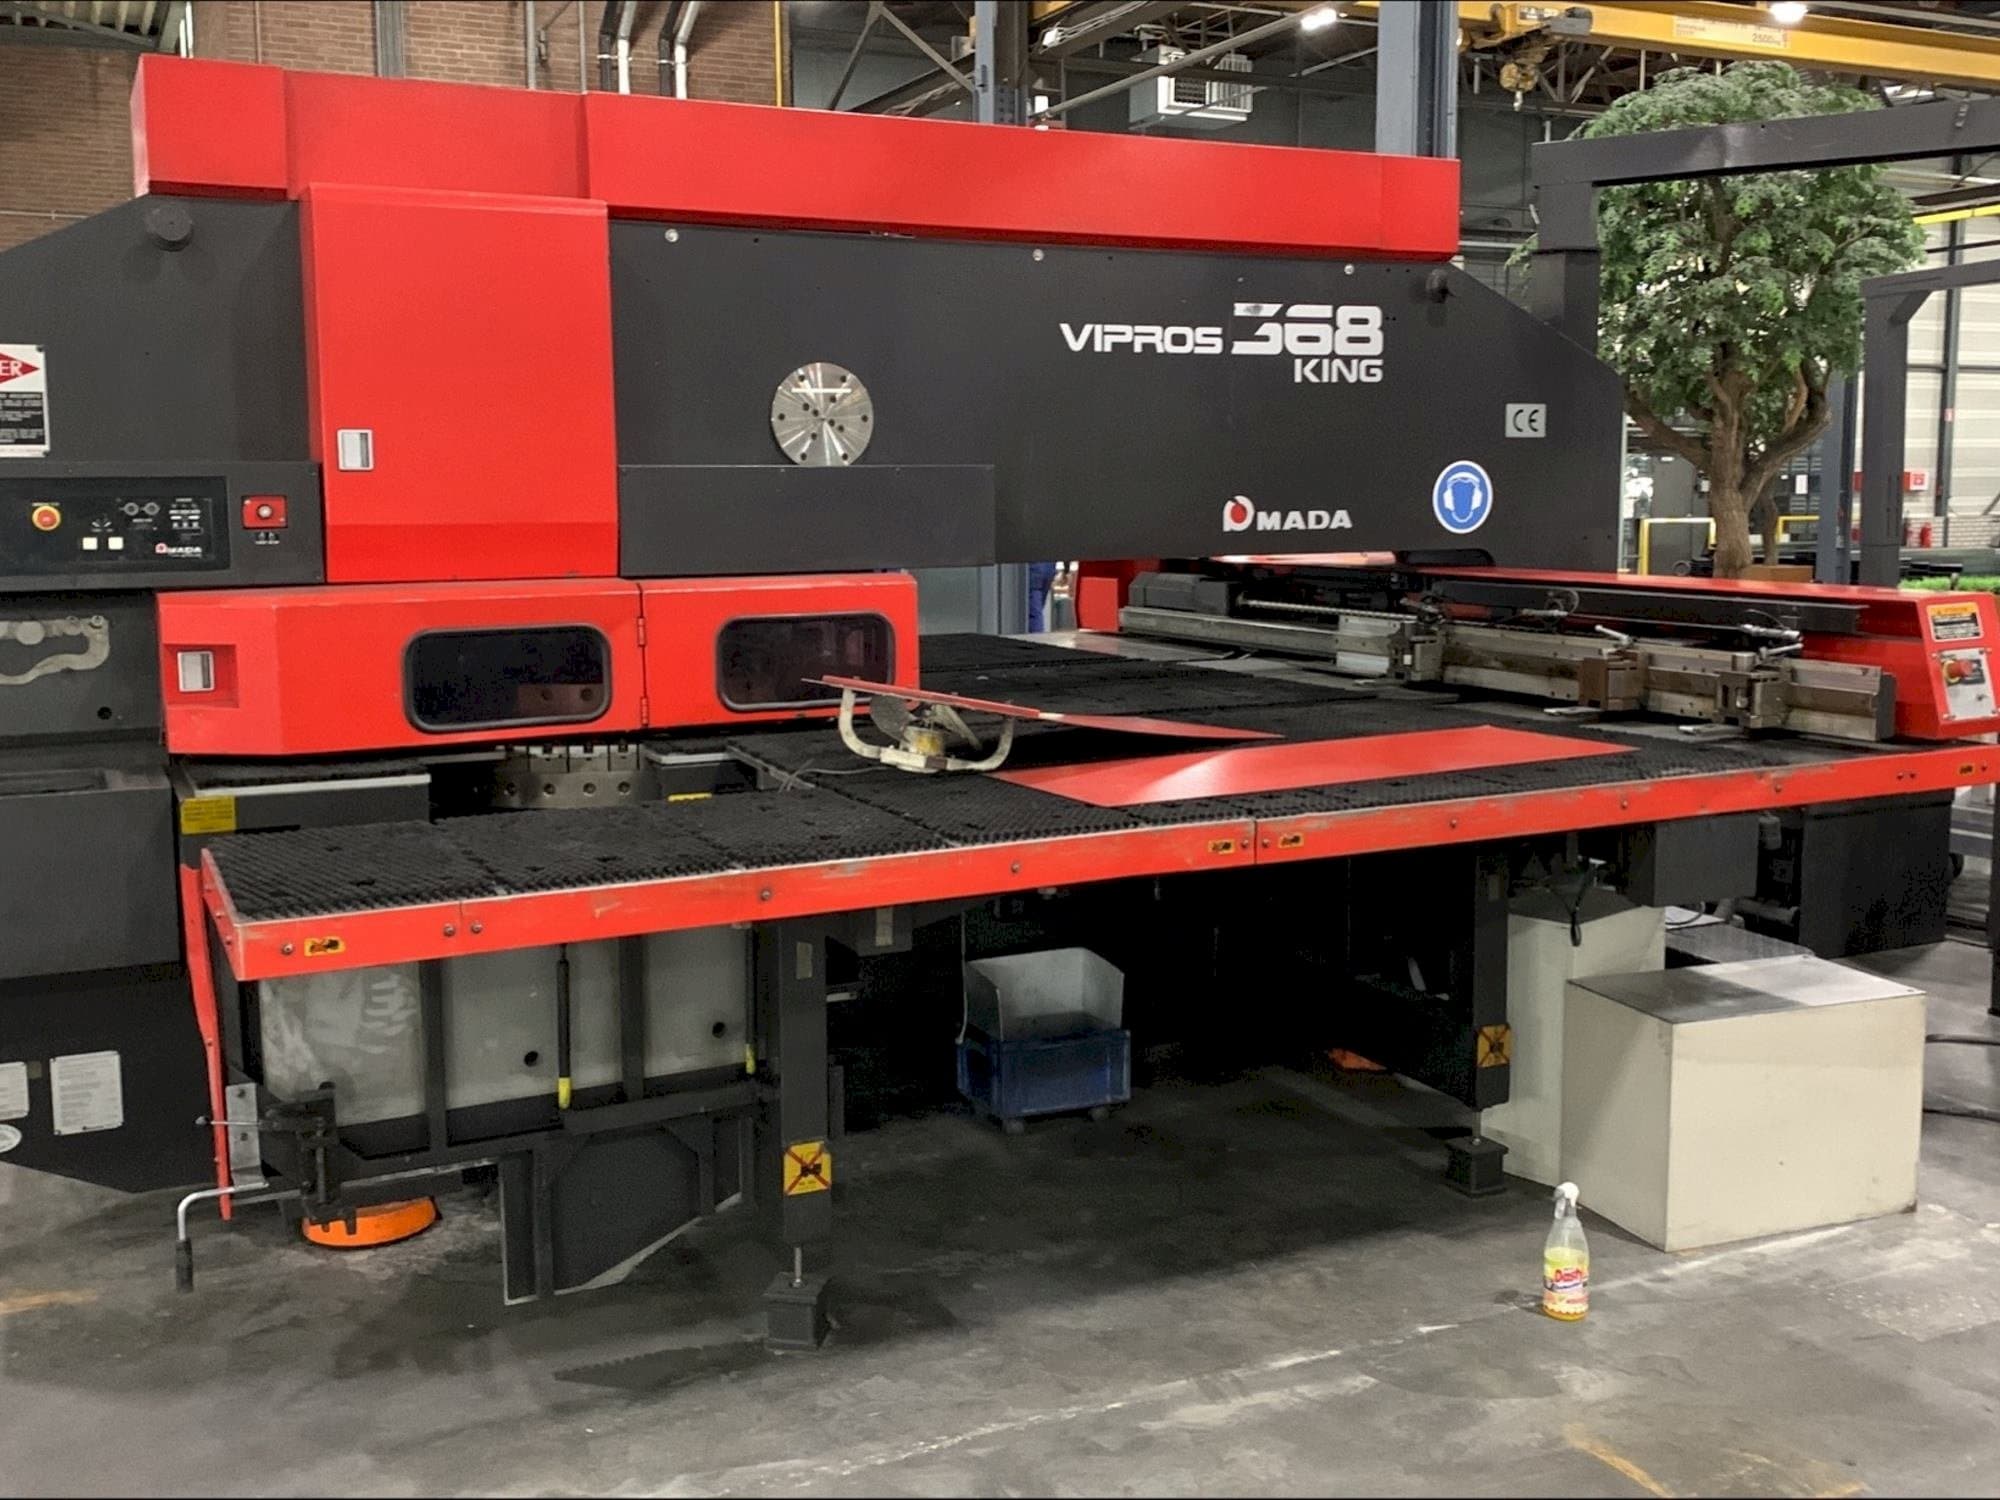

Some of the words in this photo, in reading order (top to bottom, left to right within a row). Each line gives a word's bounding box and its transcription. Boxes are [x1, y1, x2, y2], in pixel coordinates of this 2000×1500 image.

[1059, 323, 1223, 354] VIPROS
[1231, 303, 1384, 356] 368
[1294, 358, 1383, 383] KING
[1513, 409, 1539, 432] CE
